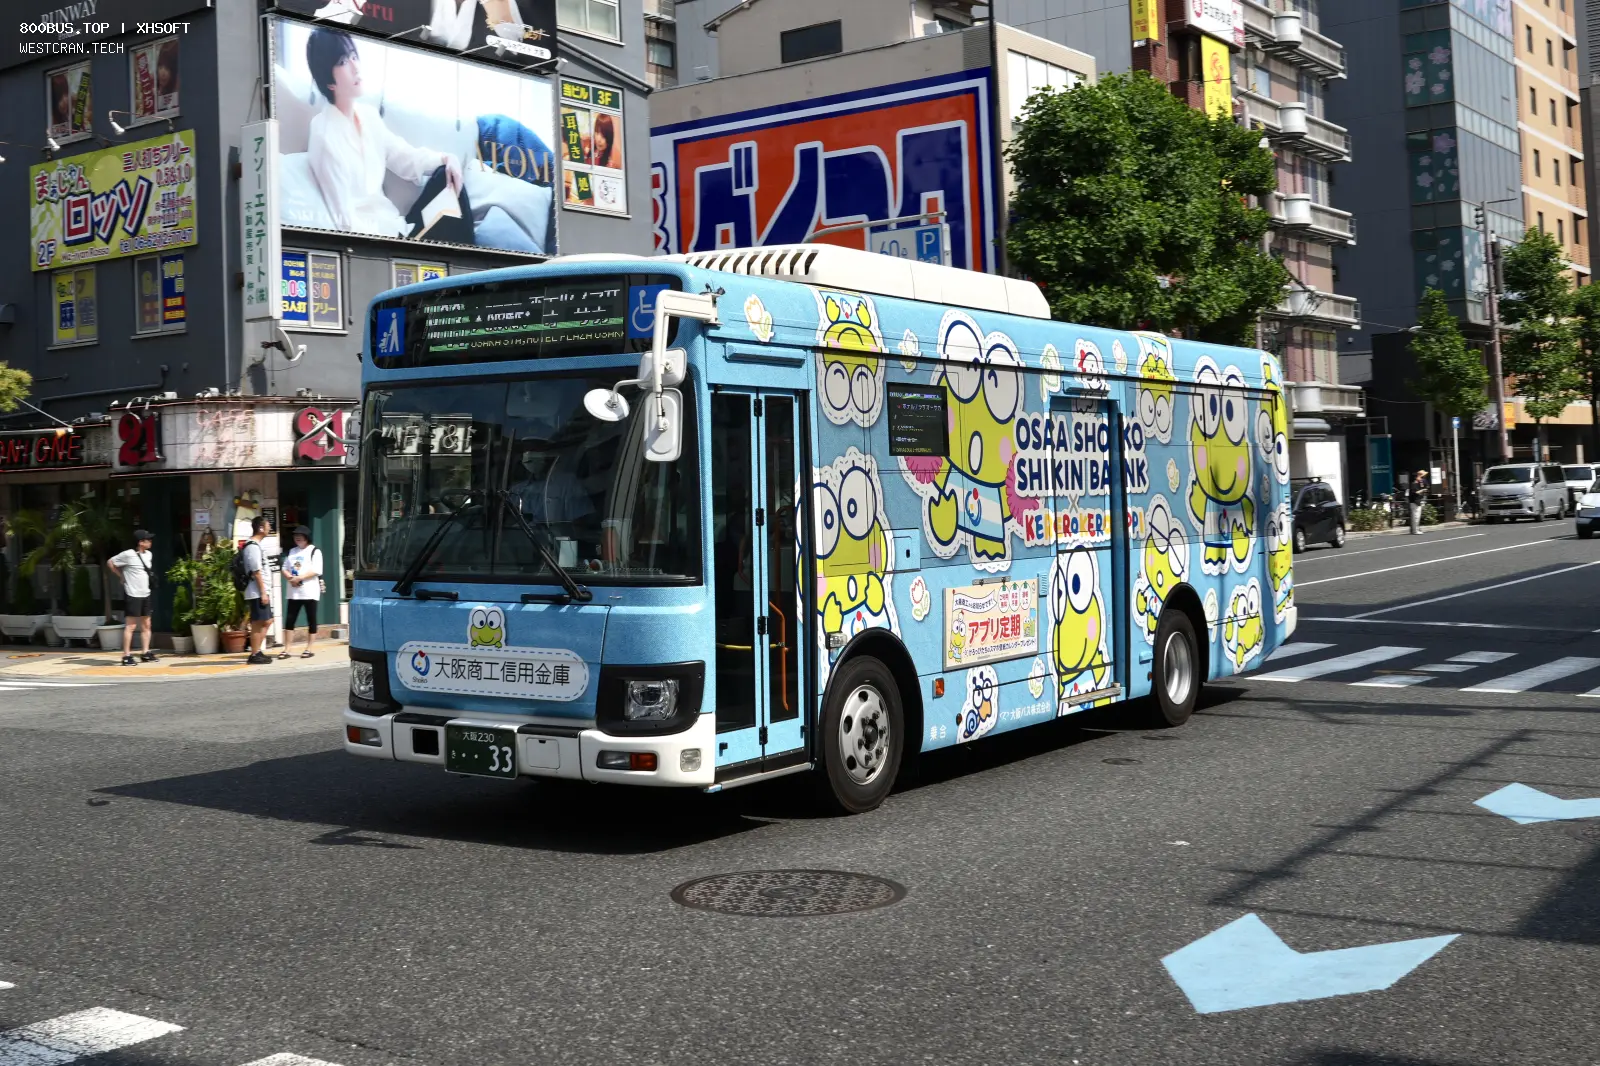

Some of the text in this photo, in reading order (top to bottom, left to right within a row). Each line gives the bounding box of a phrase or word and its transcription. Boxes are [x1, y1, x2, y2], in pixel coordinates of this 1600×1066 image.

[562, 84, 612, 105] 当ビル 3F
[64, 175, 152, 246] ロッソ
[37, 240, 56, 267] 2F
[922, 231, 935, 254] P
[119, 413, 159, 466] 21
[295, 406, 346, 461] 21
[1016, 417, 1068, 451] OSAA
[968, 614, 1021, 645] アプリ定期
[434, 657, 571, 686] 大阪商工信用金庫
[1010, 702, 1051, 721] 大阪バス株式会社
